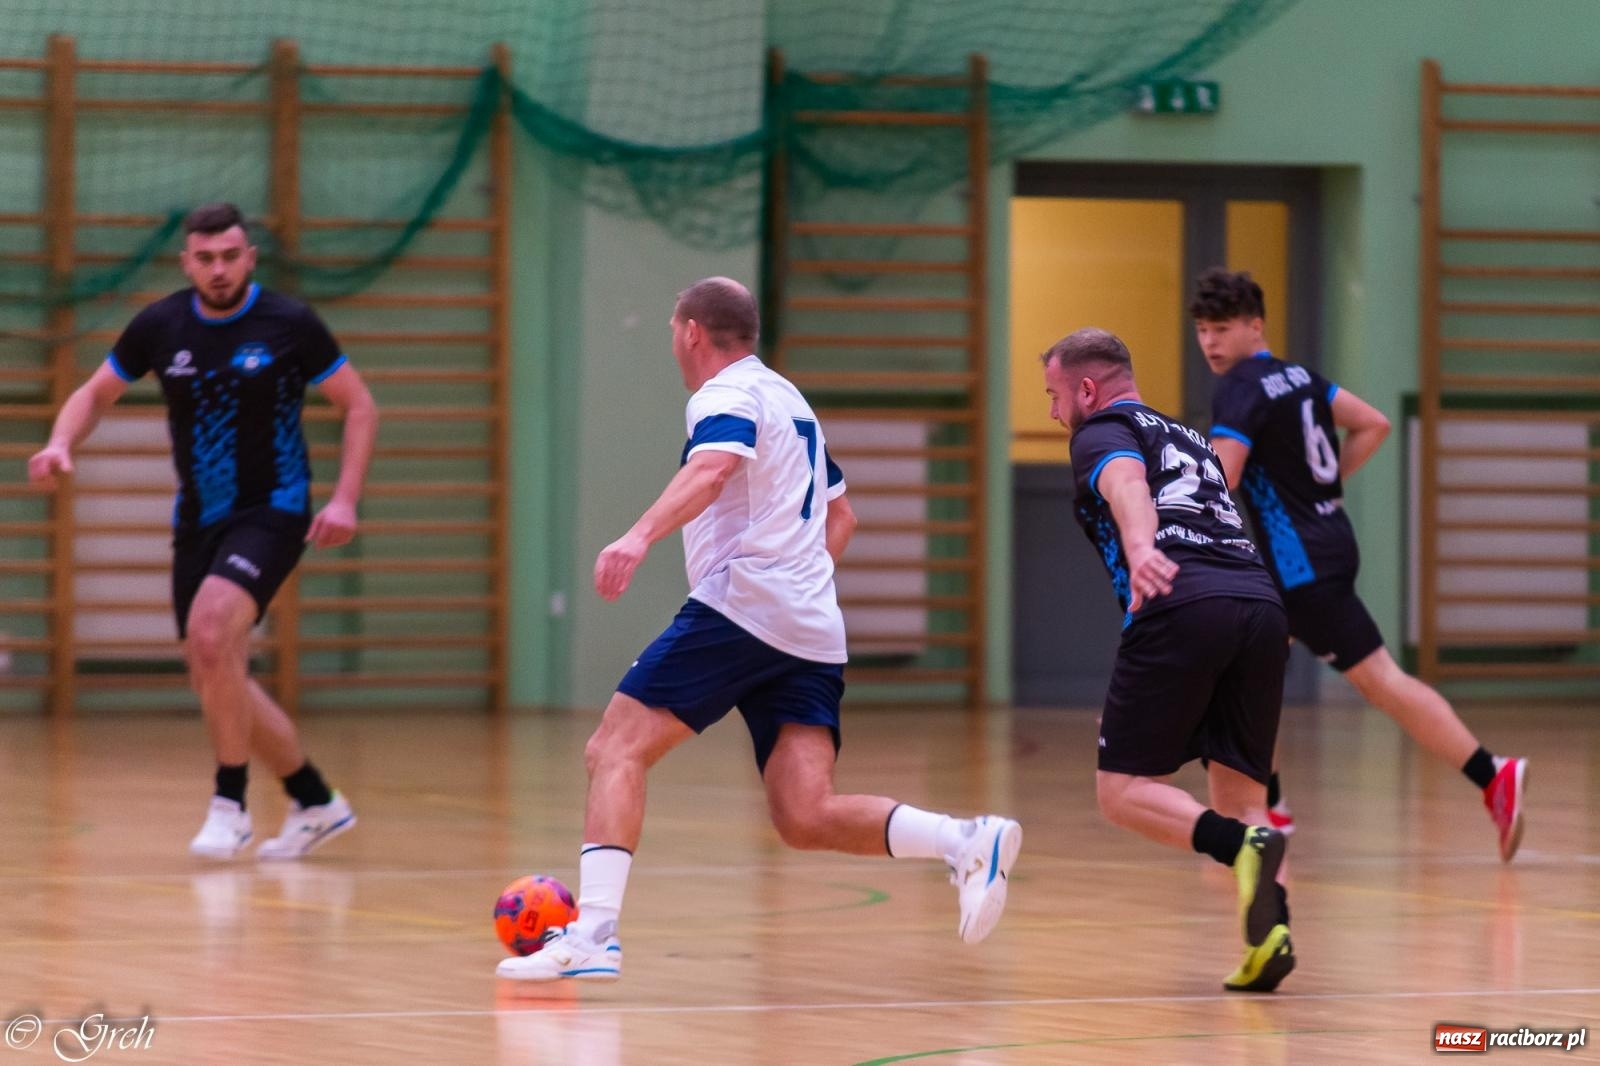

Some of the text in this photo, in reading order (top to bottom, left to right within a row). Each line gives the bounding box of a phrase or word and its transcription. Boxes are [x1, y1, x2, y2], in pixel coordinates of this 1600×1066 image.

[790, 416, 817, 522] 7
[1301, 398, 1338, 484] 6
[1153, 443, 1243, 529] 23
